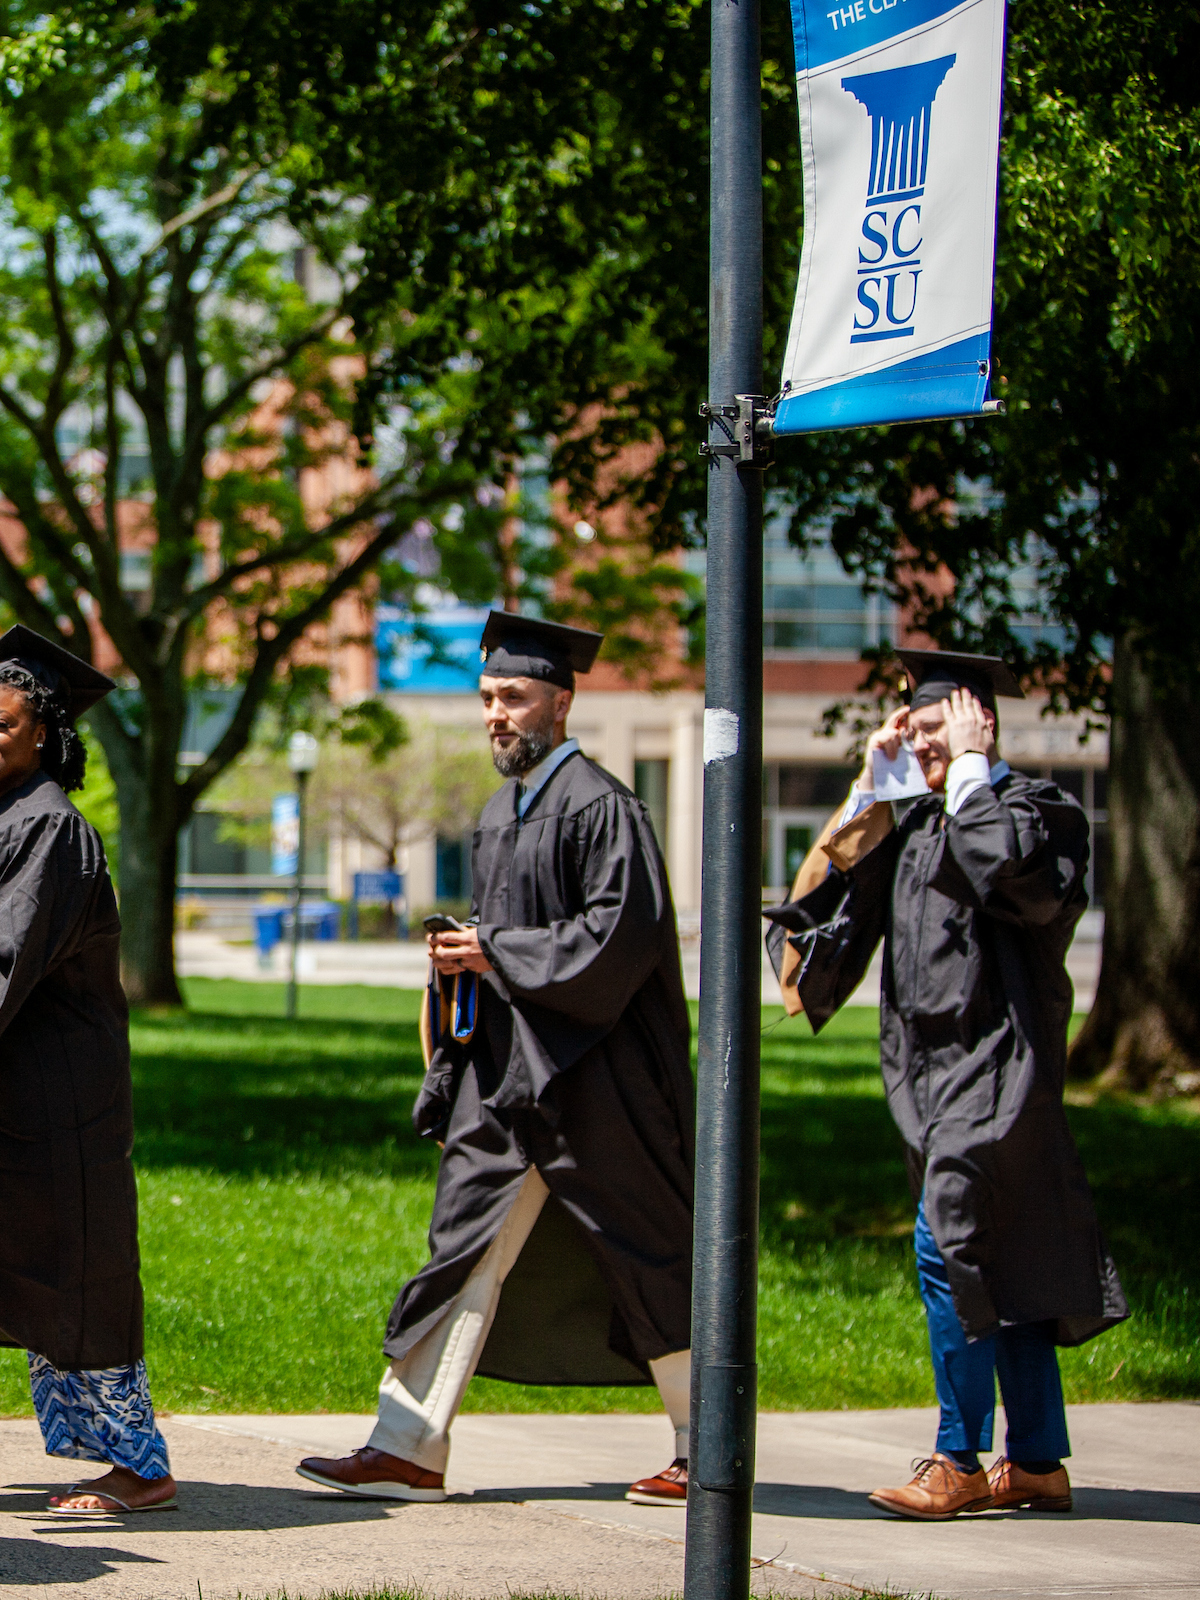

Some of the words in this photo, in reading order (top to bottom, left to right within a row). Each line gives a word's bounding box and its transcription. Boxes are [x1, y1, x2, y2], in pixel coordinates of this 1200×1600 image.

[826, 0, 867, 31] THE
[858, 205, 923, 264] SC
[853, 269, 923, 330] SU
